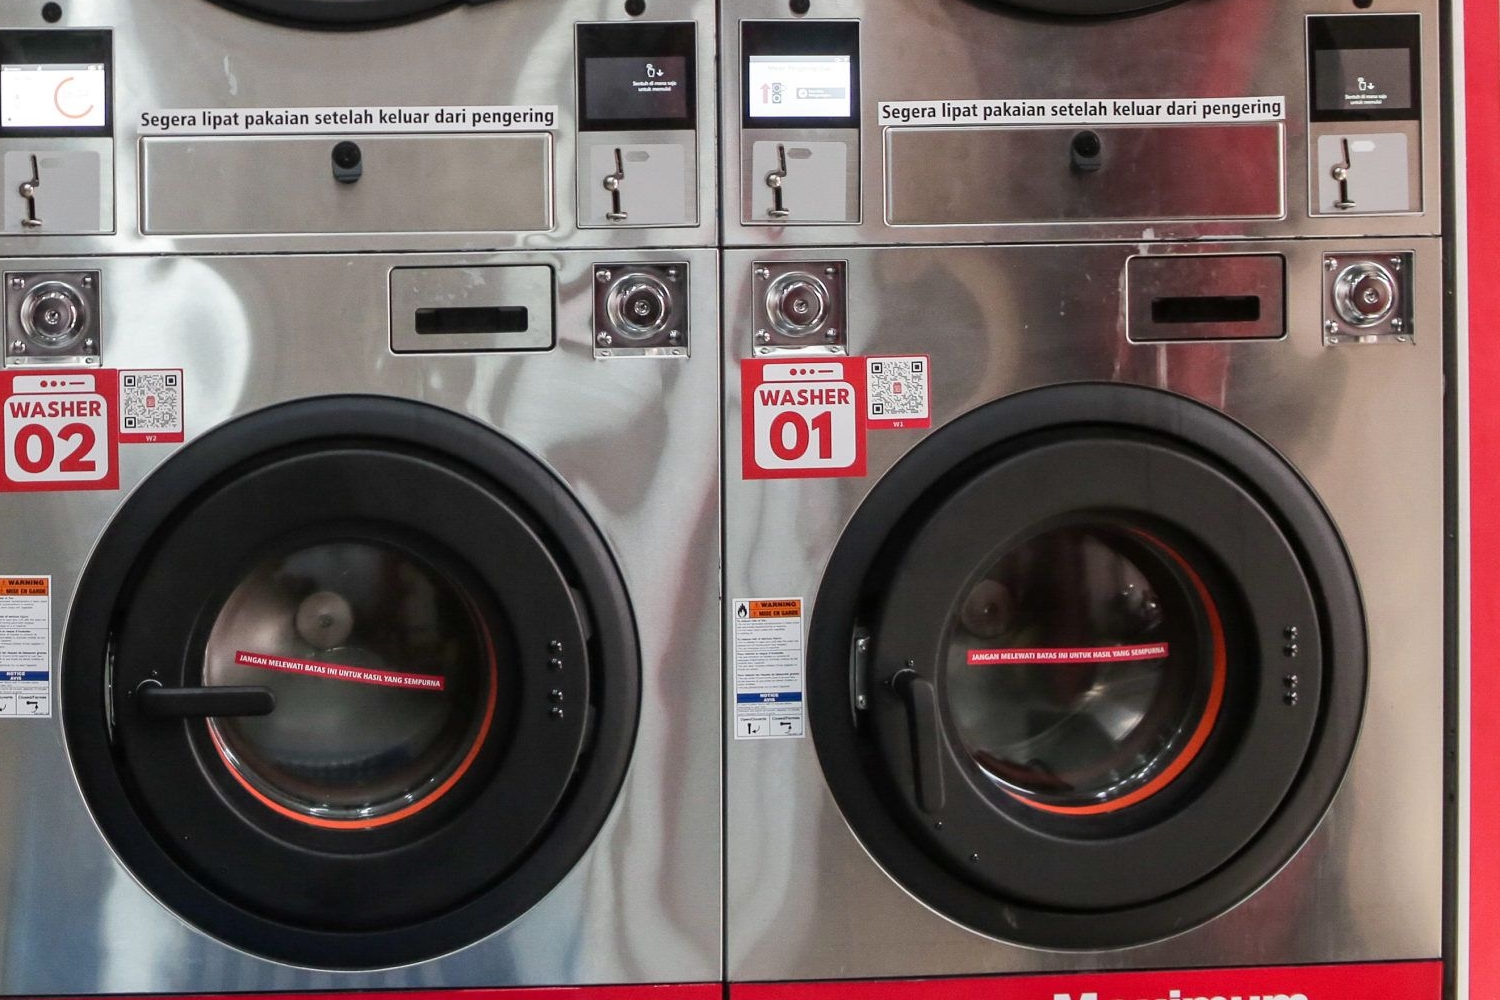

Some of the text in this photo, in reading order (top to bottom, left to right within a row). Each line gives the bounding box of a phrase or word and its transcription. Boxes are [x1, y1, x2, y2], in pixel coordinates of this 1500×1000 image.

[141, 108, 554, 130] Segera lipat pakaian setelah keluar dari pengering
[883, 99, 1281, 122] Segera lipat pakaian setelah keluar dari pengering
[759, 388, 849, 406] WASHER
[9, 401, 101, 418] WASHER
[769, 411, 832, 461] 01
[14, 423, 96, 473] 02
[240, 655, 440, 687] JANGAN MELEWATI BATAS INI UNTUK HASIL YANG SEMPURNA
